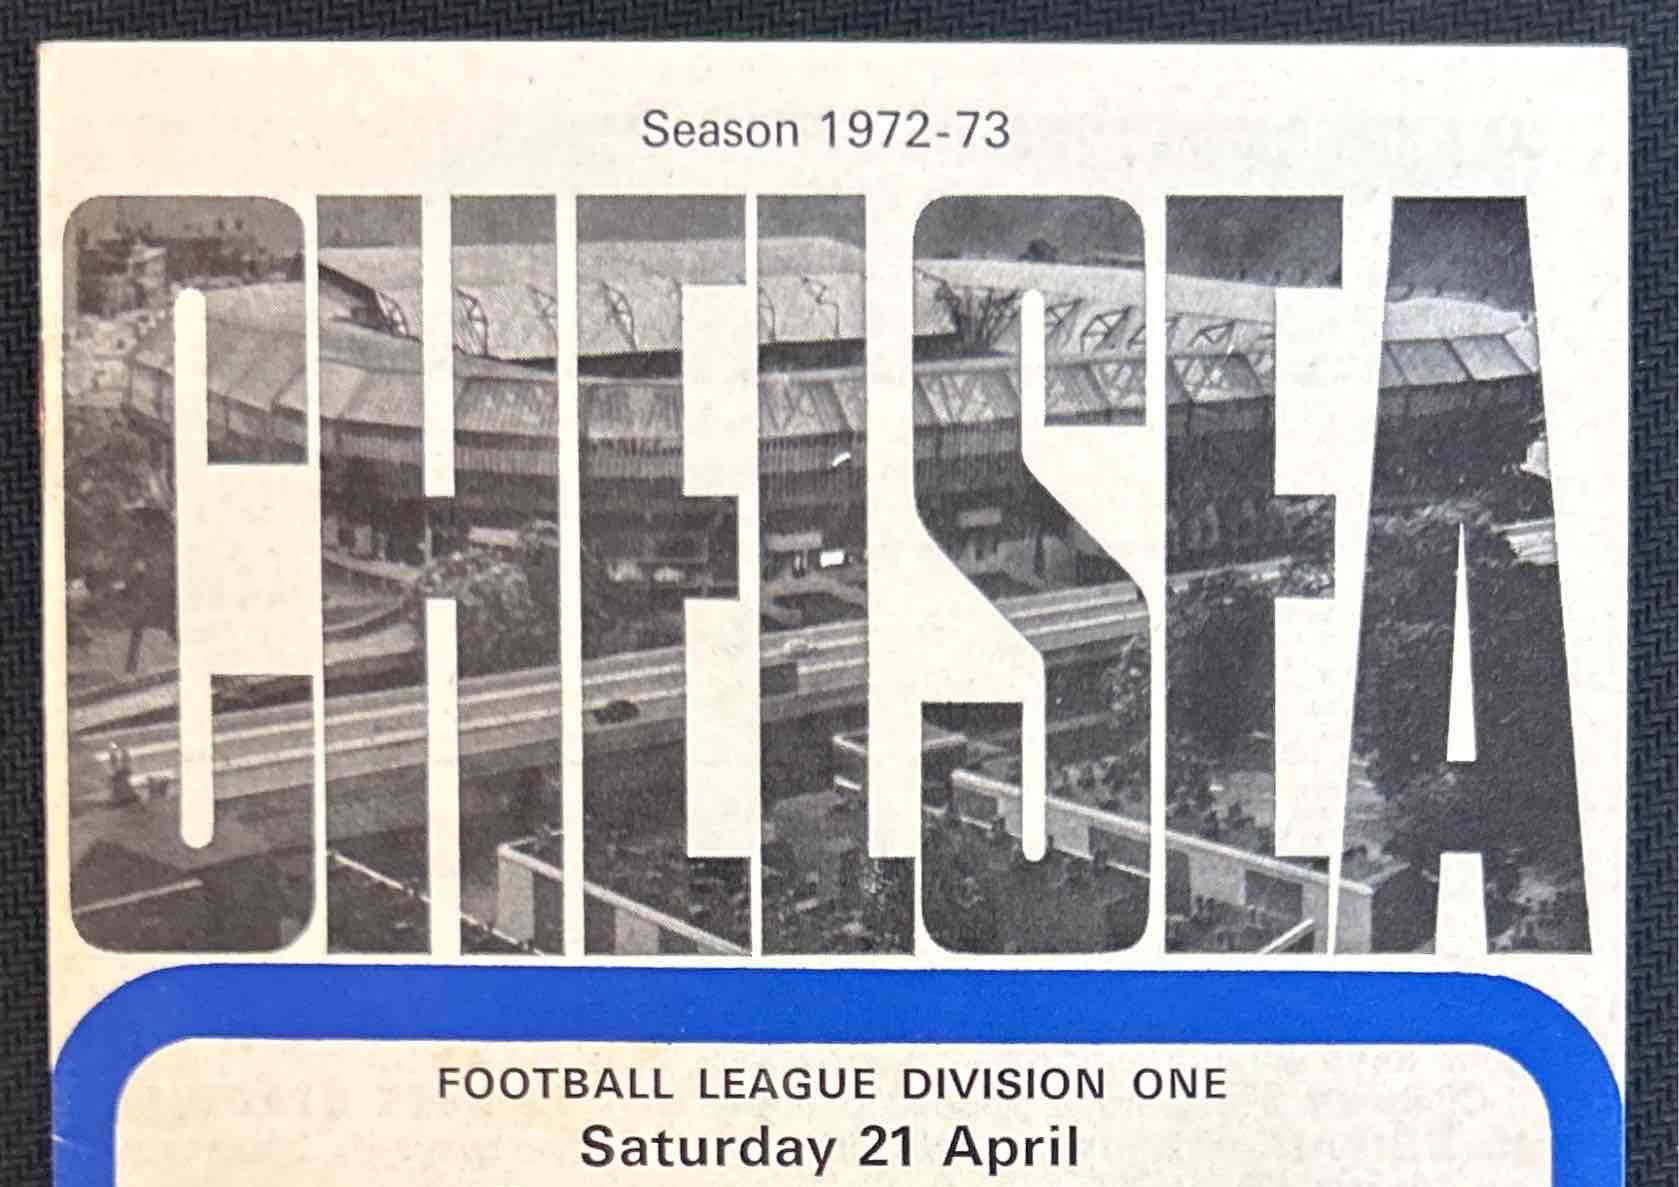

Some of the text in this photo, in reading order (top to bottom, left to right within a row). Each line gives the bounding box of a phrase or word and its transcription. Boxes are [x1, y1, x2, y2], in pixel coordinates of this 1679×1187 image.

[644, 109, 1010, 148] Season 1972-73
[63, 195, 1592, 956] CHELSEA
[440, 1068, 1226, 1100] FOOTBALL LEAGUE DIVISION ONE
[582, 1125, 1077, 1177] Saturday 21 April
